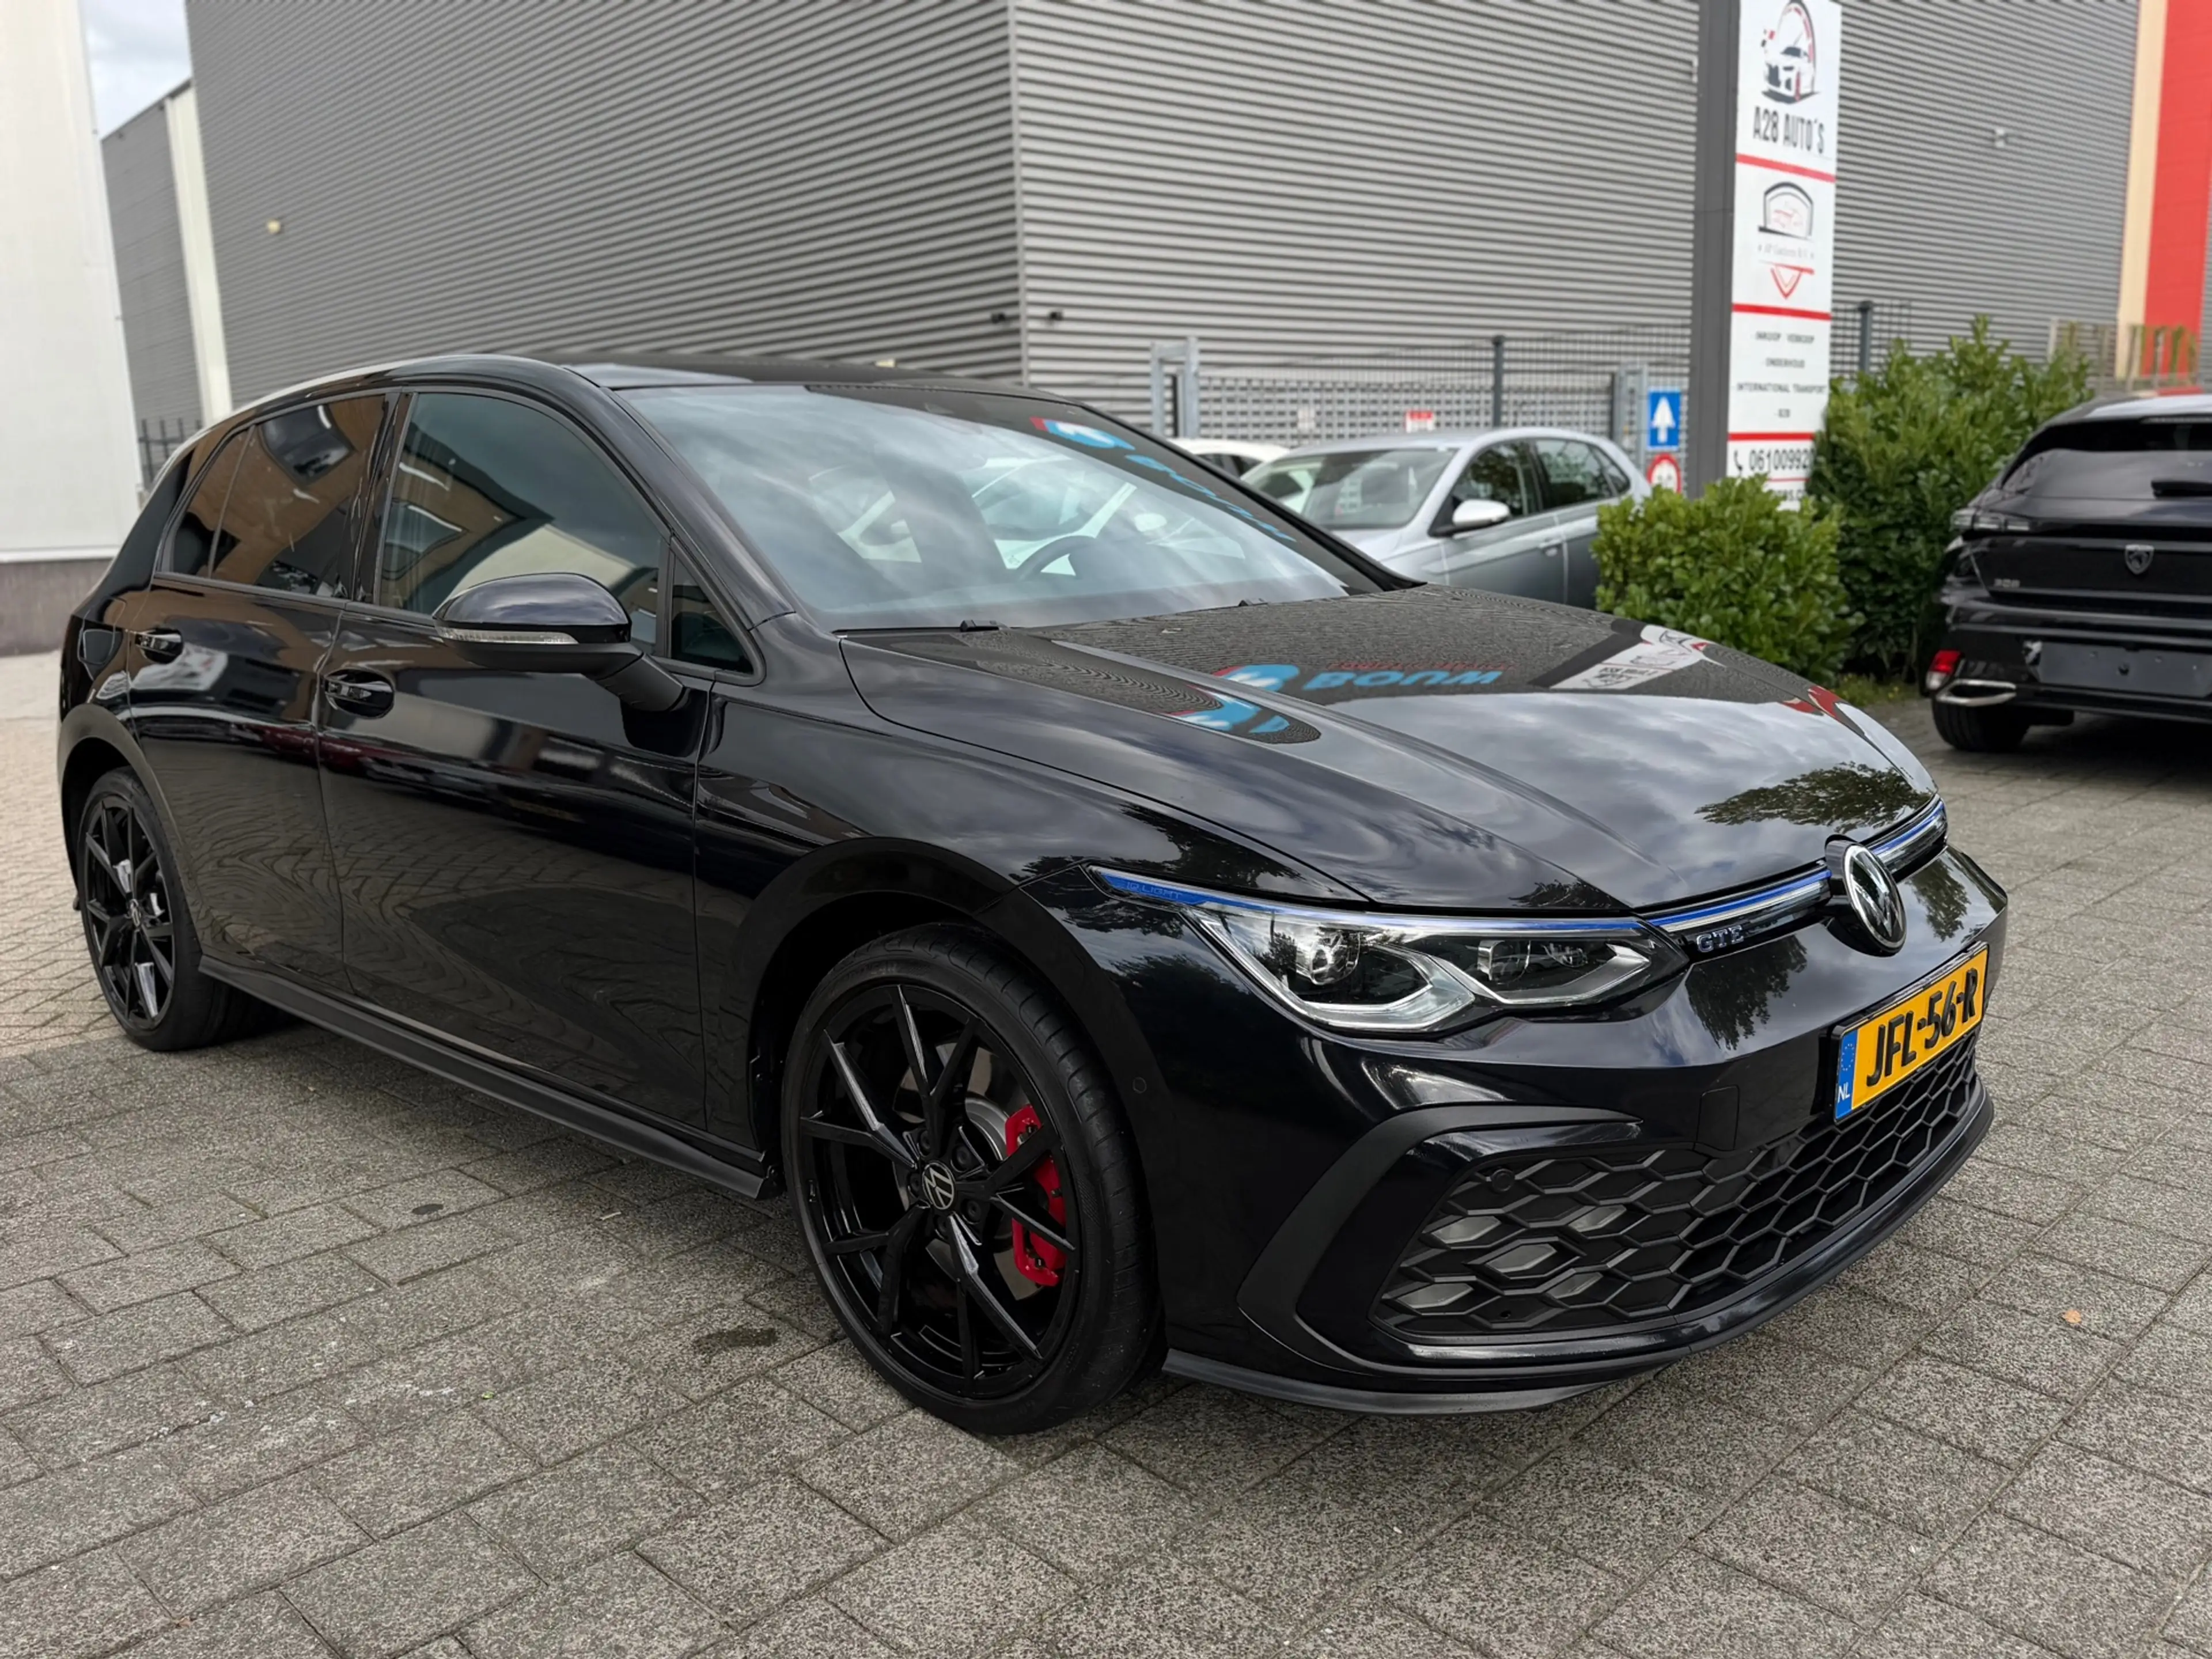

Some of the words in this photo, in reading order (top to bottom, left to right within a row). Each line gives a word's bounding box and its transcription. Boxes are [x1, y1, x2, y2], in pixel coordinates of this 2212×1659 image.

[1753, 106, 1779, 143] A28
[1737, 383, 1790, 393] INTERNATIONAL
[1696, 925, 1744, 952] GTE
[1866, 968, 1978, 1087] JFL-56-R
[1838, 1082, 1850, 1103] NL
